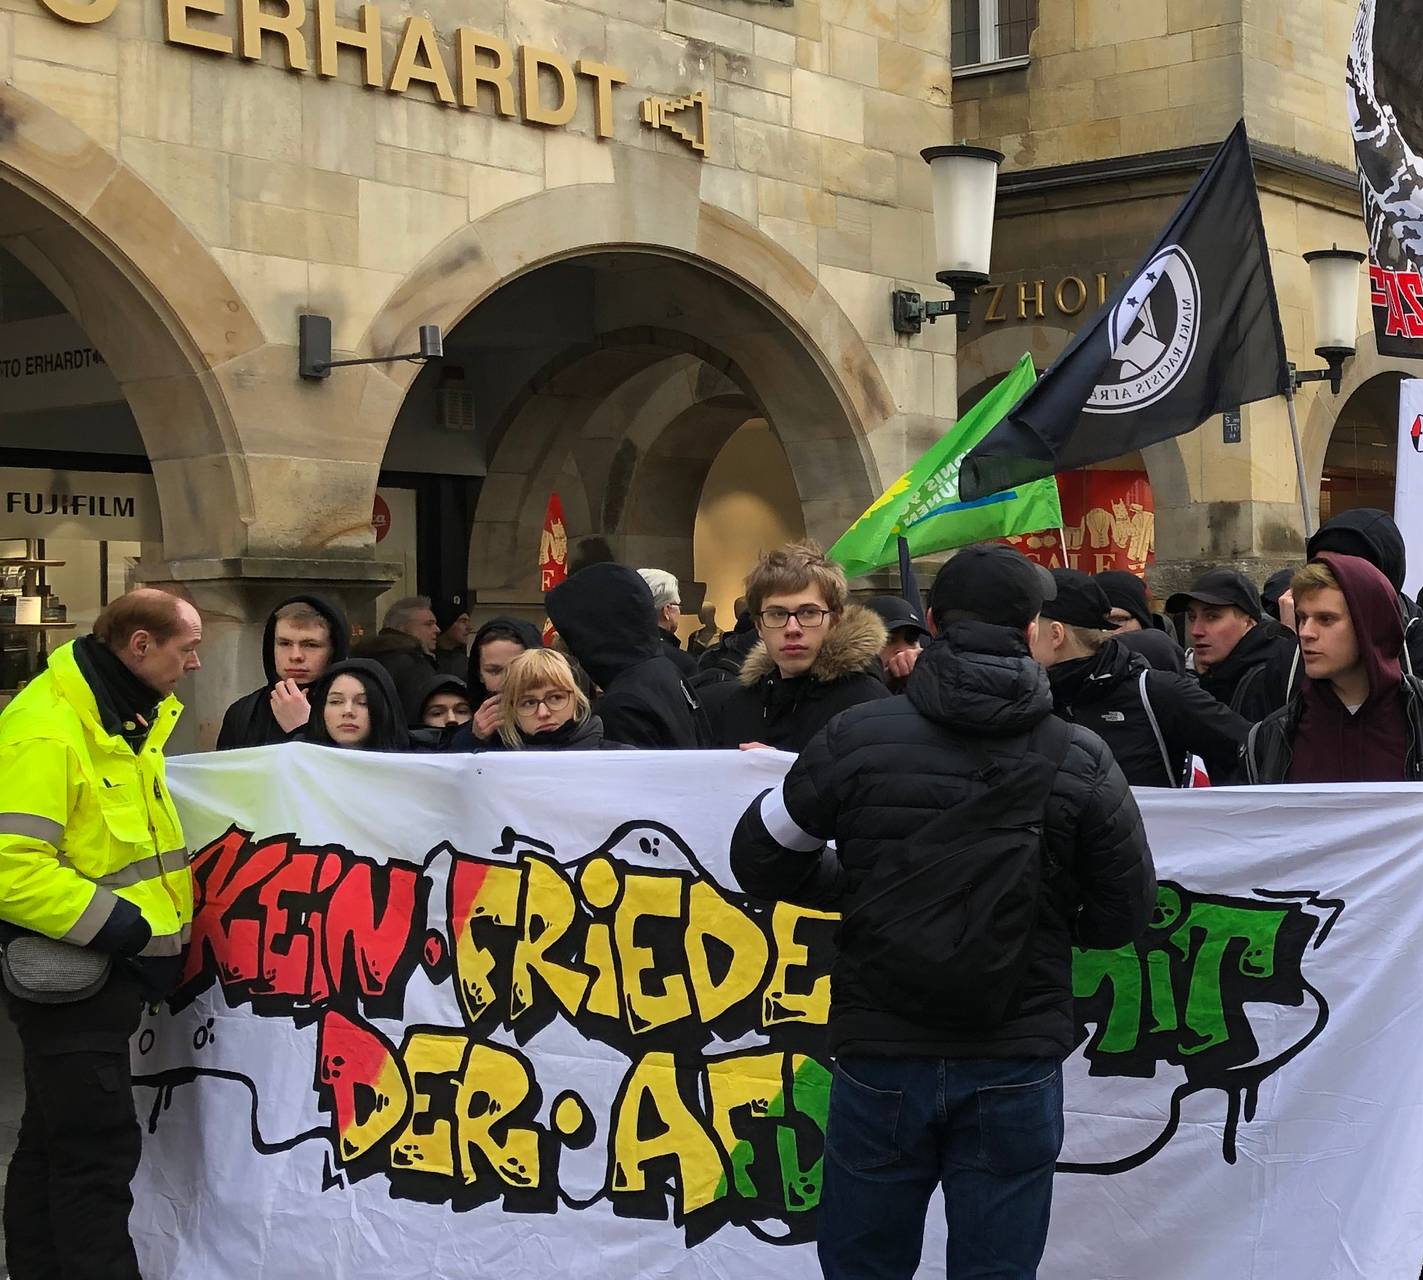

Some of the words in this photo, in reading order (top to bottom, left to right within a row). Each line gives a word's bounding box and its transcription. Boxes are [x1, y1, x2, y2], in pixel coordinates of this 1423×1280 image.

[163, 0, 627, 138] ERHARDT
[25, 348, 92, 376] ERHARDT
[6, 491, 135, 518] FUJIFILM
[318, 1006, 543, 1190] DER
